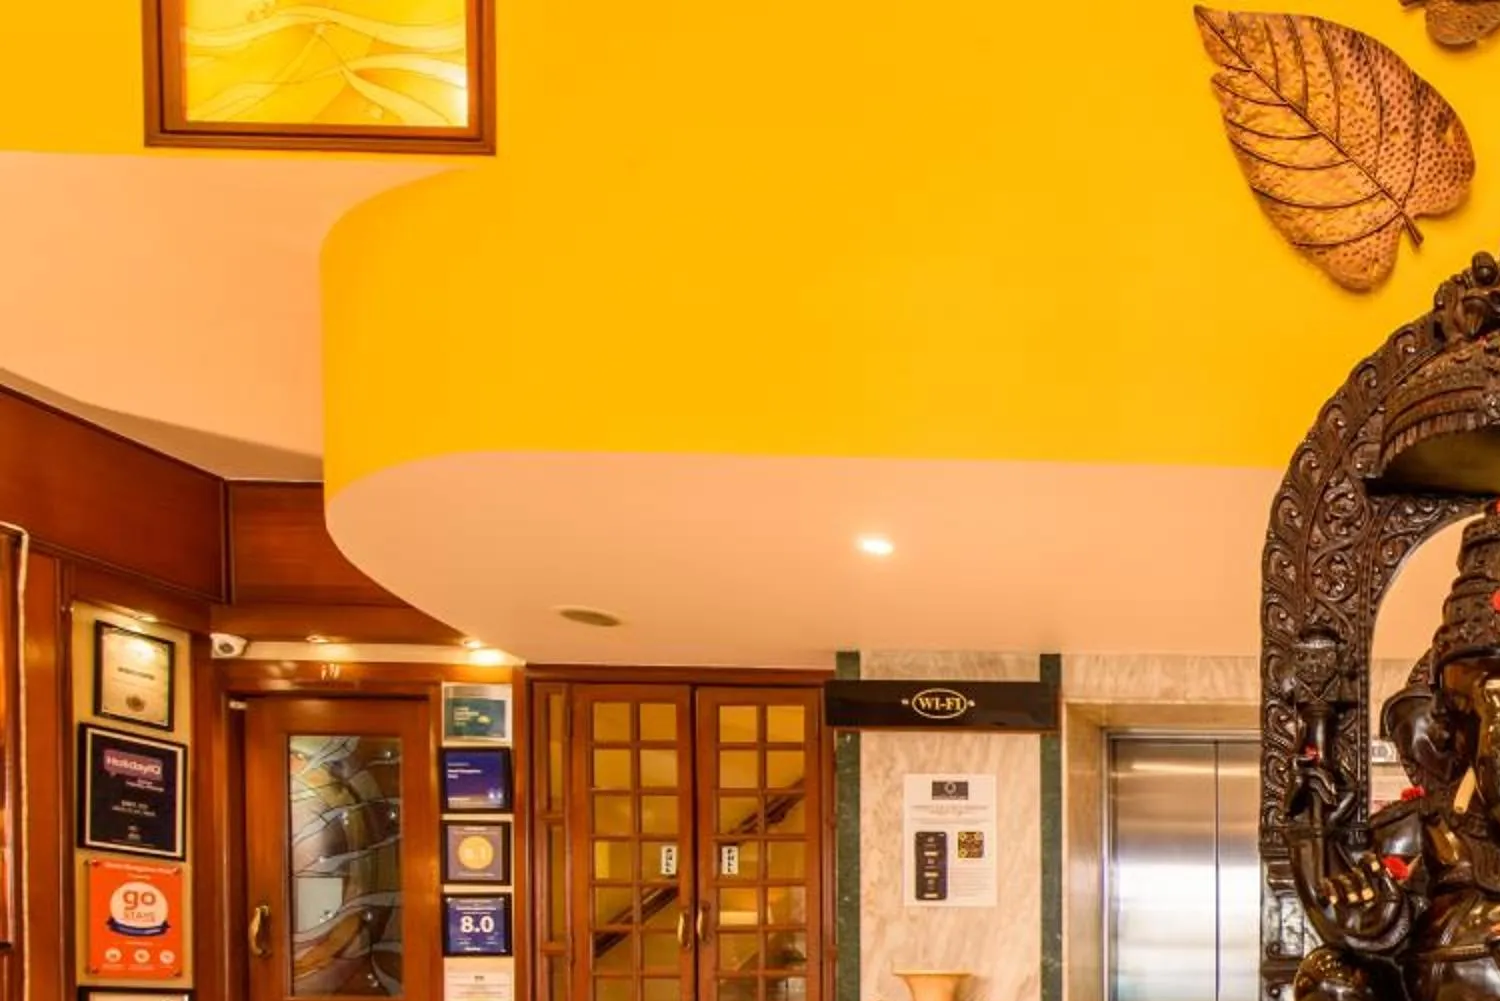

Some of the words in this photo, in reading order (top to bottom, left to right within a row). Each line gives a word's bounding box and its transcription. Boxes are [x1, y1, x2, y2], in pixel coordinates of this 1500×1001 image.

[918, 697, 961, 711] WI-FI
[123, 890, 157, 911] go
[460, 915, 495, 933] 8.0
